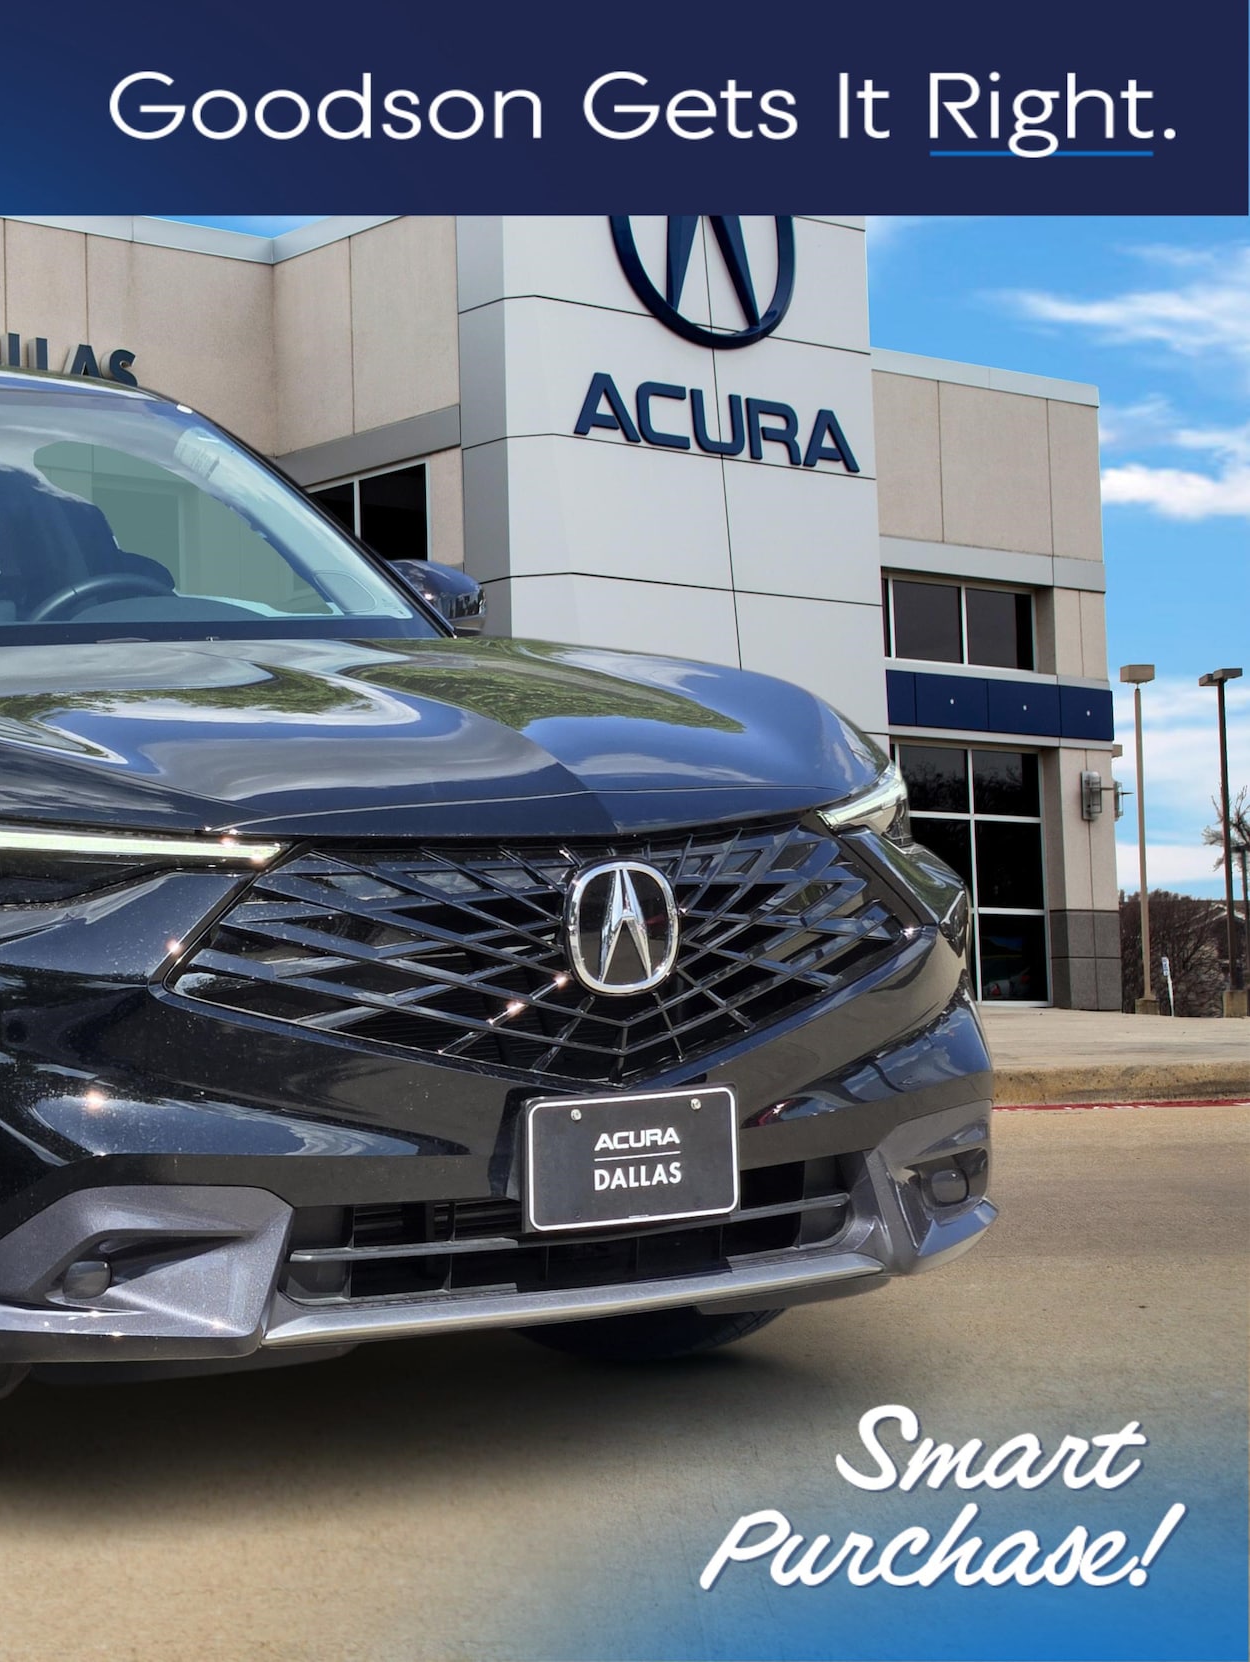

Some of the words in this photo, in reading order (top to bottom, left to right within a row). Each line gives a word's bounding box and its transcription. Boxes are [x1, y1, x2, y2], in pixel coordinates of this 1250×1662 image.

[573, 372, 860, 473] ACURA
[594, 1127, 681, 1151] ACURA
[594, 1161, 682, 1191] DALLAS
